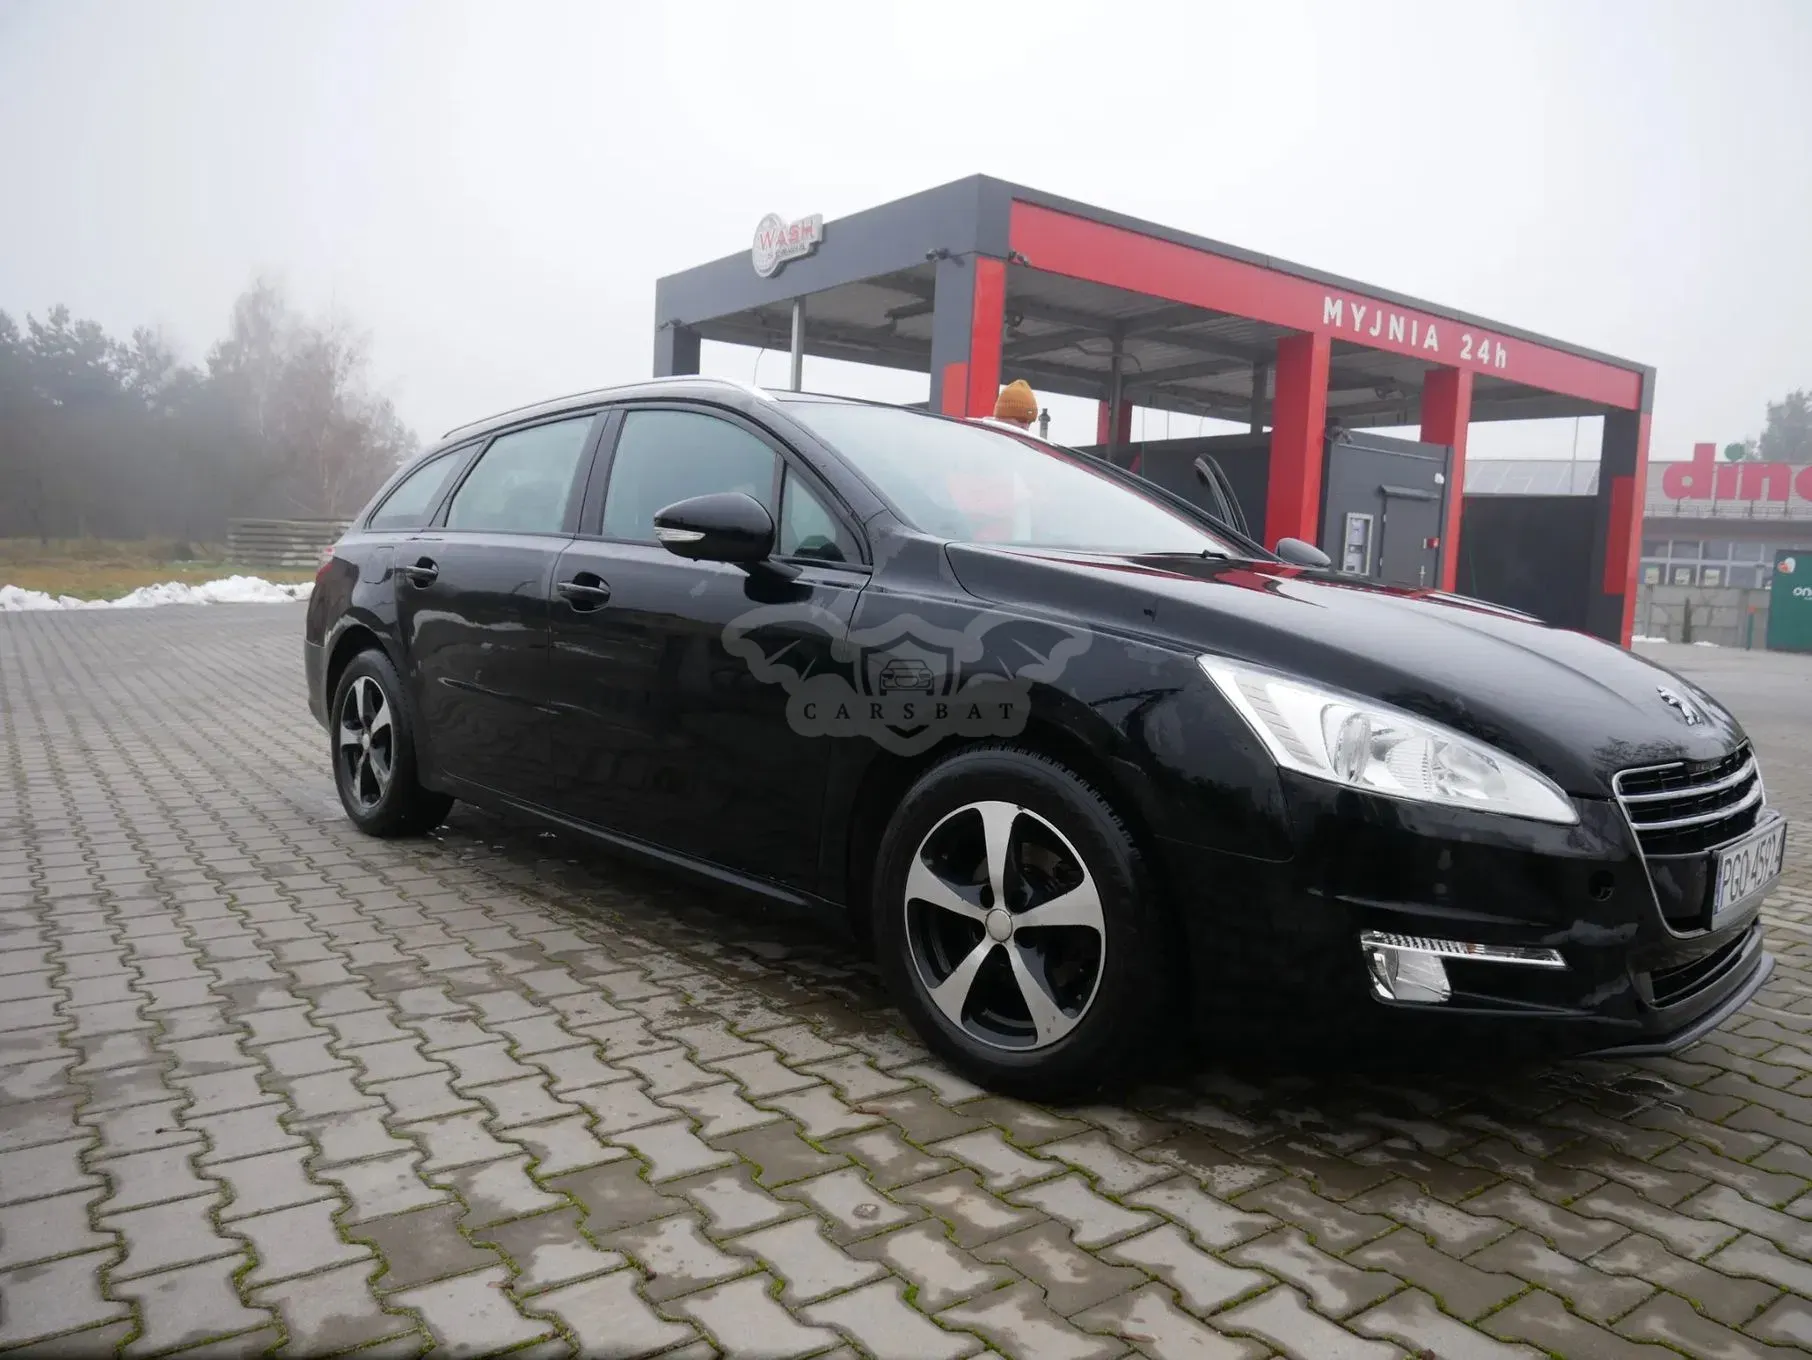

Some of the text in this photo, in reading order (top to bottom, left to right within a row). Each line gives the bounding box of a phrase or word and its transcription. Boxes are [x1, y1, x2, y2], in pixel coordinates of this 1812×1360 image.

[759, 219, 816, 251] WASH
[1323, 296, 1507, 369] MYJNIA 24h
